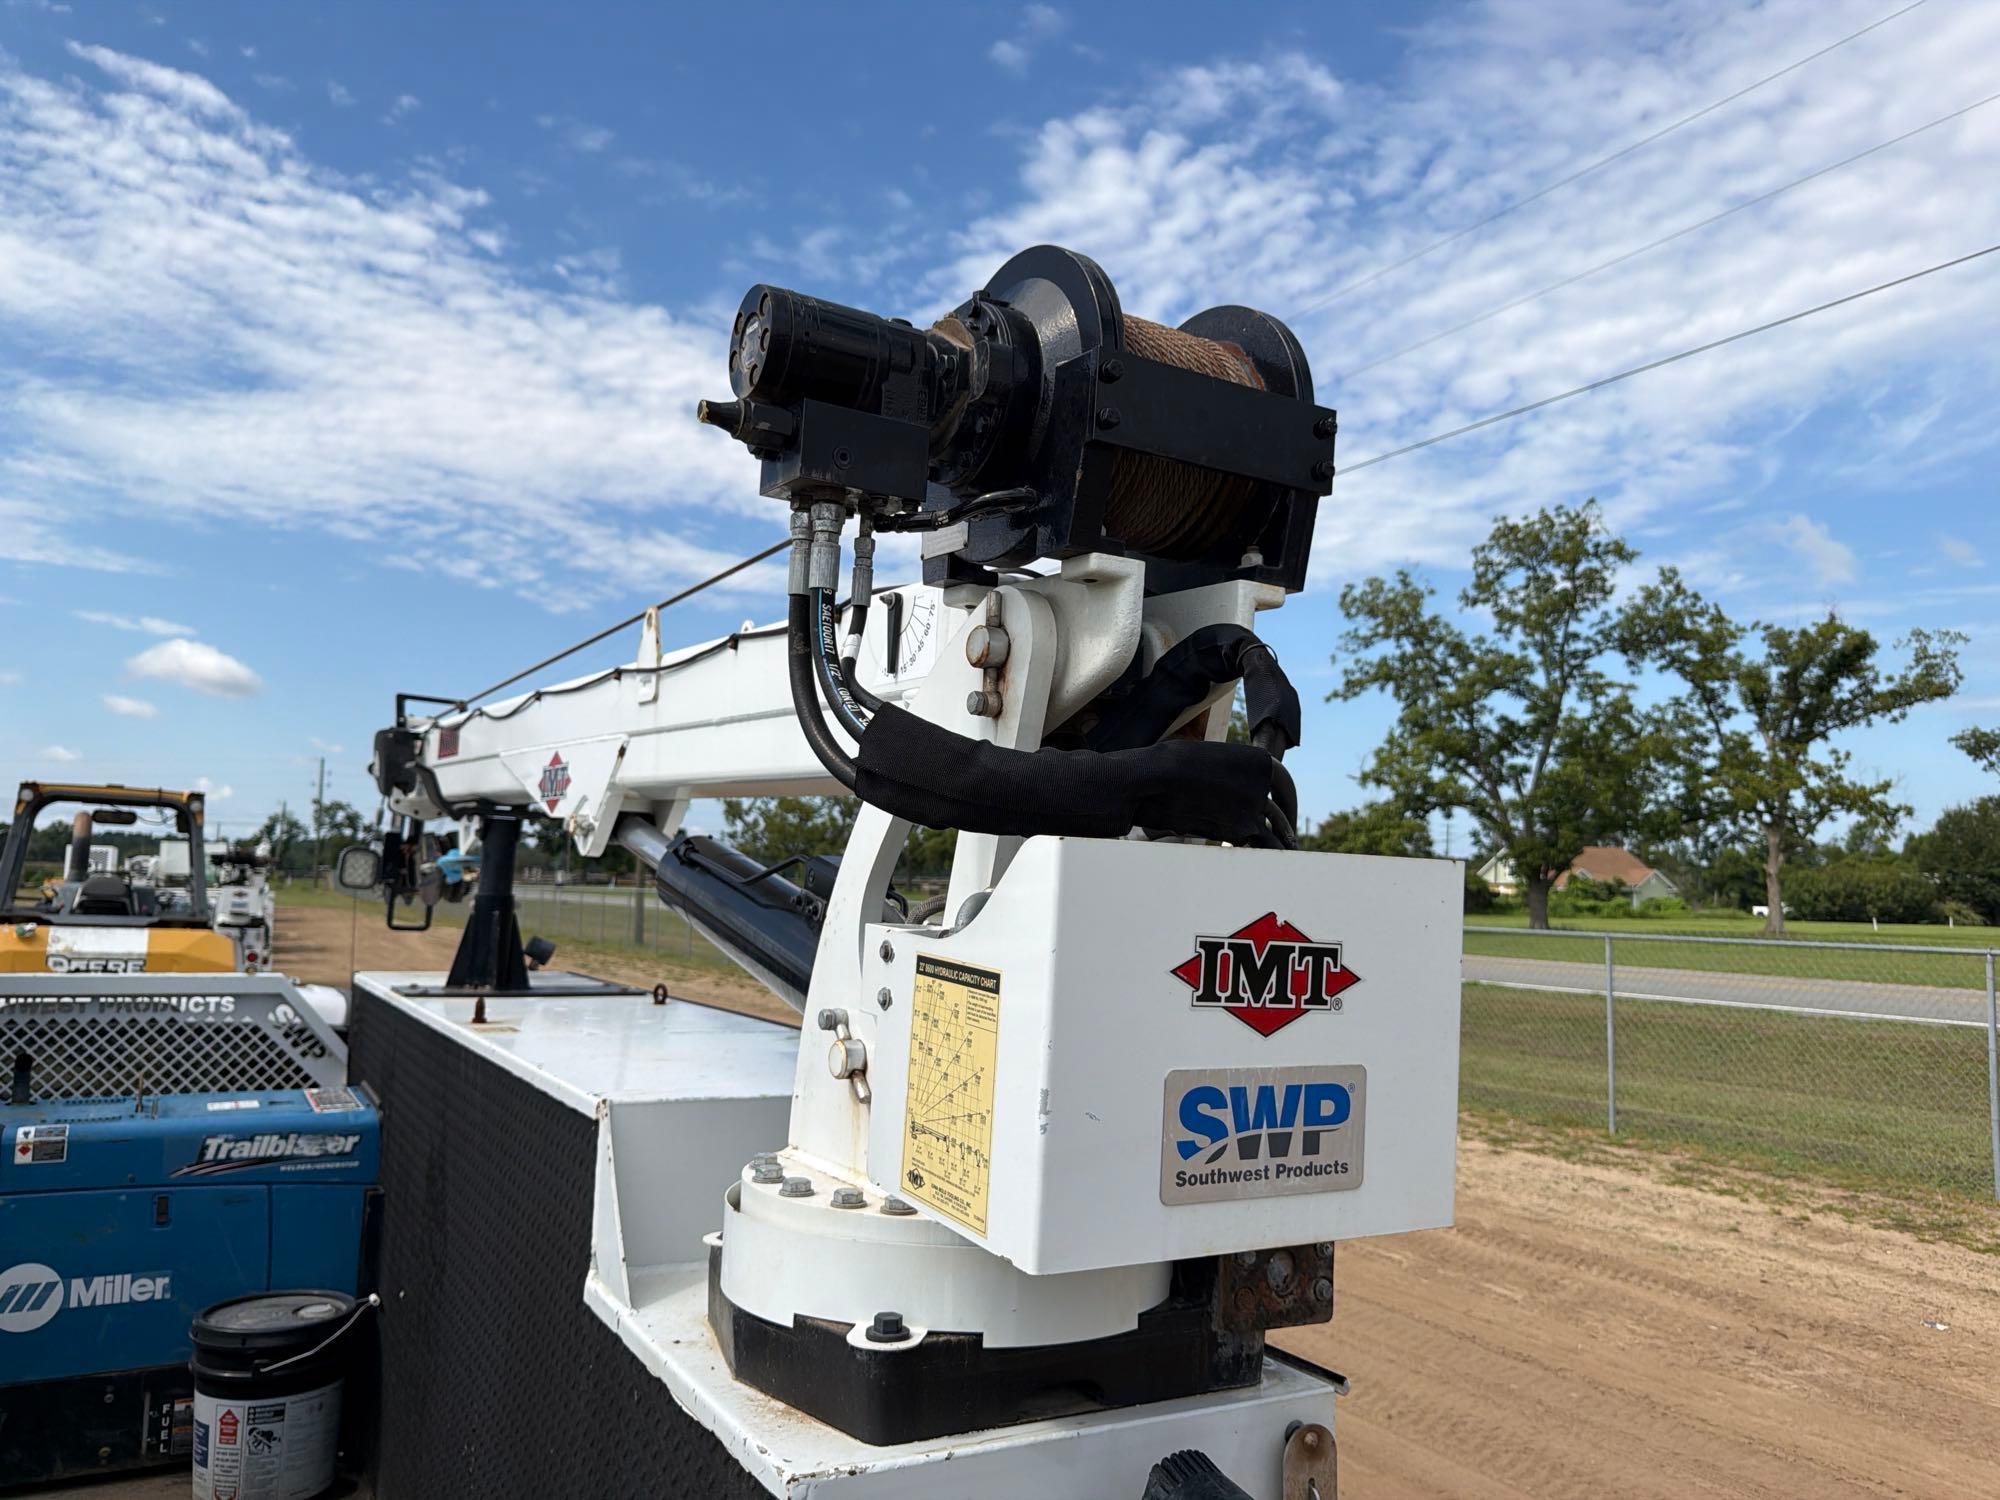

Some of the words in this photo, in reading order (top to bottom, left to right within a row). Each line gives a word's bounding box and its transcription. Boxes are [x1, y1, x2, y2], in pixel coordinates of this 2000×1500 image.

[822, 604, 836, 655] SAE100R17
[934, 965, 958, 980] HYDRAULIC
[958, 971, 980, 985] CAPACITY
[980, 976, 997, 990] CHART
[1192, 935, 1342, 1010] IMT
[99, 996, 235, 1013] PRODUCTS
[1176, 1083, 1351, 1164] SWP
[1175, 1165, 1270, 1187] Southwest
[1275, 1160, 1349, 1179] Products
[69, 1274, 170, 1309] Miller
[160, 1404, 171, 1453] FUEL
